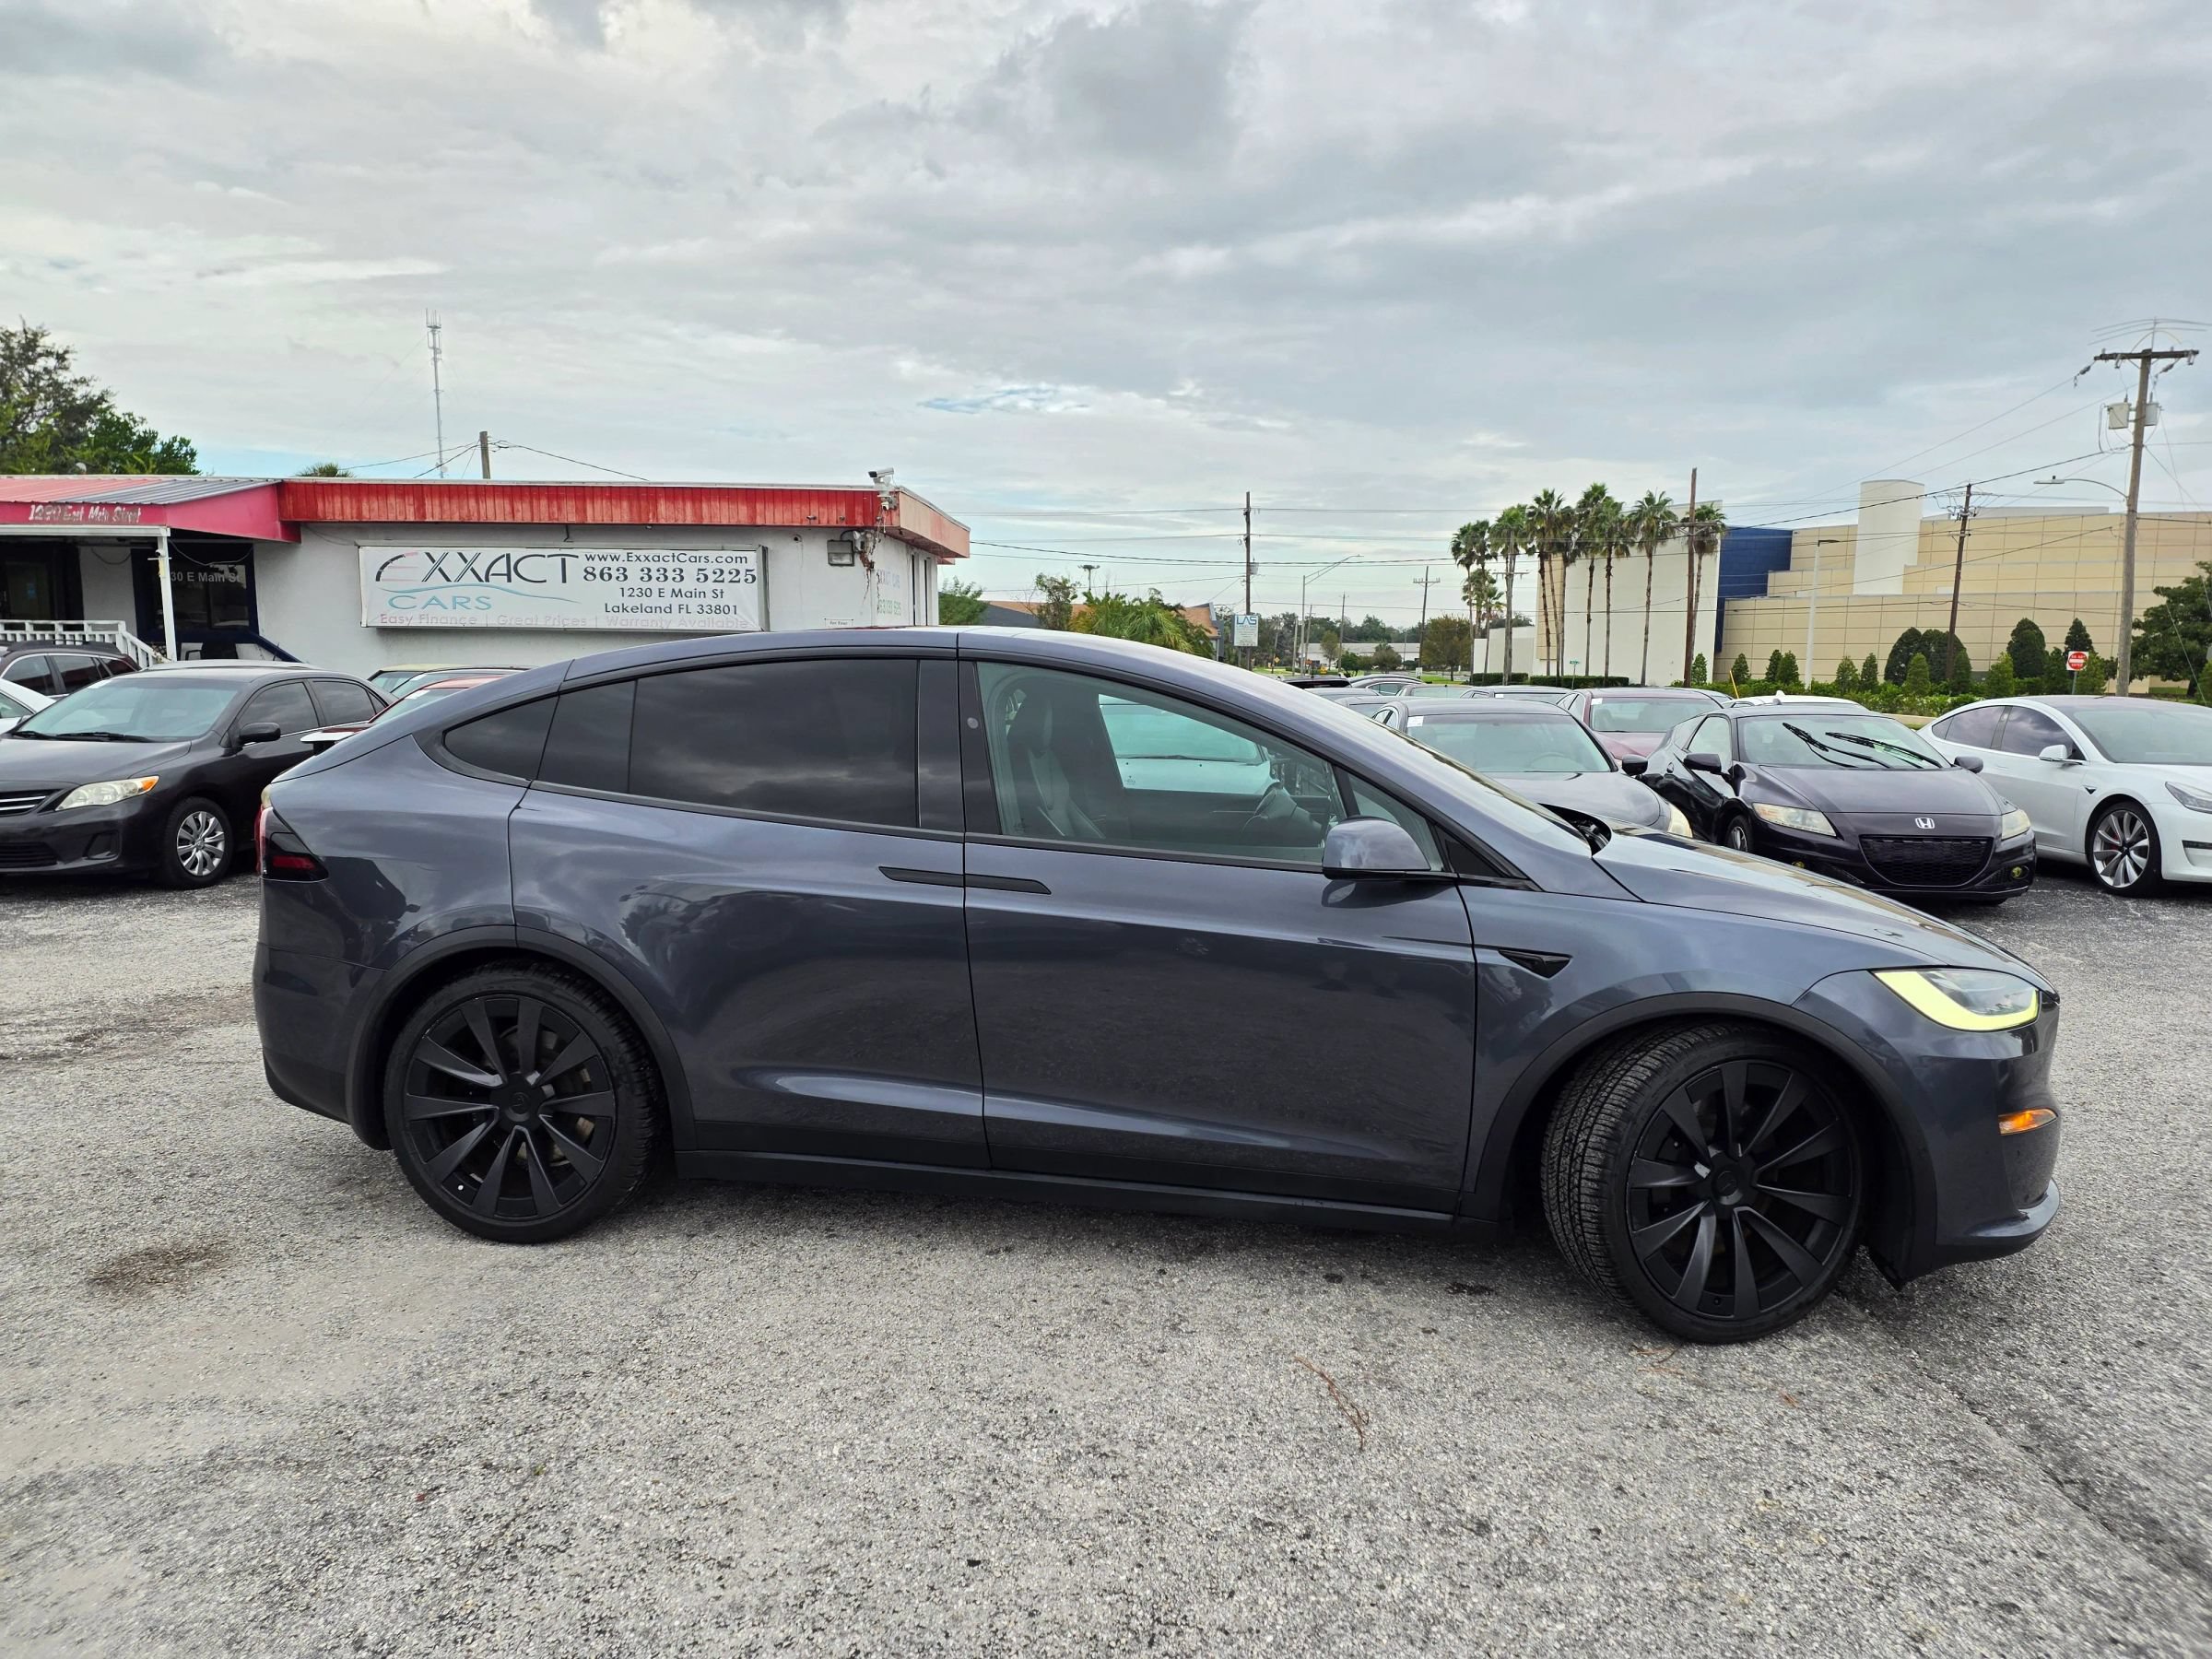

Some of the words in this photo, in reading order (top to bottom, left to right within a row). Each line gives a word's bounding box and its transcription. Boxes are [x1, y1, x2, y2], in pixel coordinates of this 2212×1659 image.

[584, 552, 747, 564] www.ExxactCars.com
[375, 552, 579, 583] EXXACT
[171, 571, 183, 582] 30
[187, 572, 194, 582] E
[198, 572, 225, 582] Main
[583, 566, 628, 582] 863
[640, 567, 685, 582] 333
[696, 568, 757, 583] 5225
[619, 587, 653, 598] 1230
[658, 588, 665, 598] E
[670, 588, 706, 598] Main
[712, 589, 725, 599] St
[388, 595, 491, 610] CARS
[605, 603, 672, 614] Lakeland
[678, 604, 691, 614] FL
[697, 605, 737, 615] 33801
[380, 614, 413, 627] Easy
[419, 614, 477, 625] Finance
[498, 615, 539, 626] Great
[545, 616, 587, 628] Prices
[1236, 615, 1257, 625] LAS
